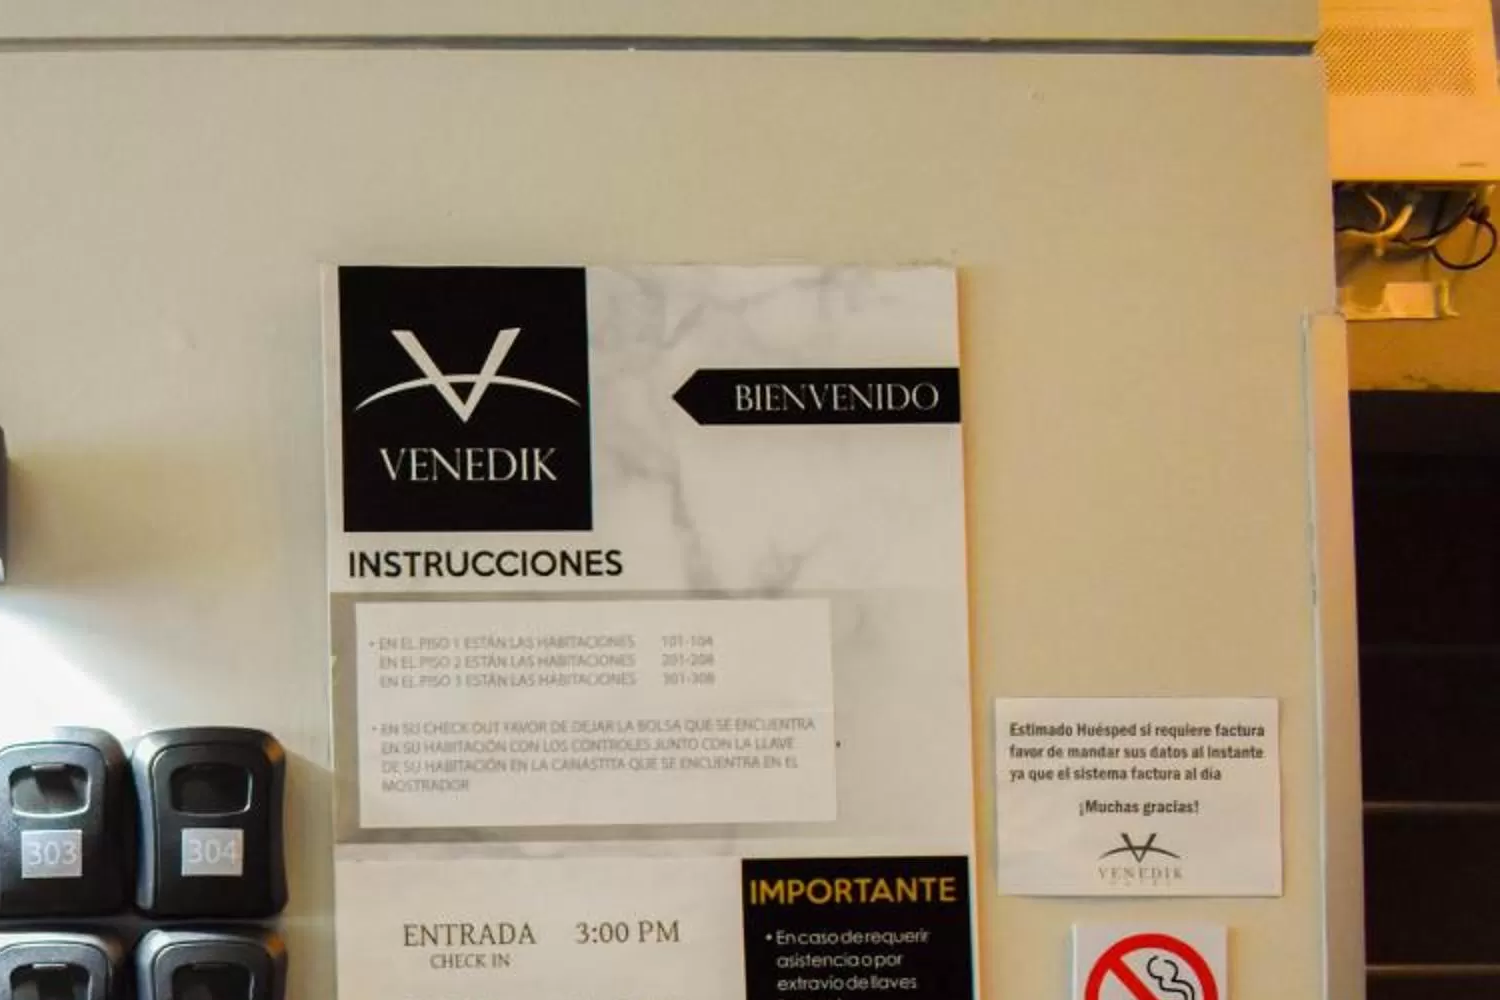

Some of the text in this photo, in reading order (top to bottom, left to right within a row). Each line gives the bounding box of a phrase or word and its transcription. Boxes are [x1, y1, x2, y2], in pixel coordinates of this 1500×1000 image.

[734, 381, 940, 412] BIENVENIDO
[379, 447, 557, 482] VENEDIK
[348, 549, 623, 577] INSTRUCCIONES
[379, 637, 397, 650] EN
[537, 636, 636, 648] HABITACIONES
[380, 656, 398, 668] EN
[537, 654, 636, 667] HABITACIONES
[380, 675, 398, 688] EN
[538, 673, 637, 686] HABITACIONES
[471, 720, 500, 734] OUT
[637, 719, 682, 732] BOLSA
[684, 719, 712, 732] QUE
[1009, 722, 1073, 737] Estimado
[1077, 722, 1137, 740] Huésped
[1155, 723, 1212, 740] requiere
[1215, 723, 1265, 737] factura
[543, 739, 568, 752] LOS
[1009, 744, 1264, 758] favor de mandar sus datos al instante
[1009, 769, 1025, 782] ya
[1028, 769, 1053, 782] que
[1057, 767, 1071, 781] el
[1073, 767, 1127, 781] sistema
[1131, 767, 1181, 781] factura
[1184, 767, 1197, 781] al
[1079, 800, 1199, 816] ¡Muchas gracias!
[27, 840, 77, 865] 303
[188, 838, 237, 865] 304
[1097, 867, 1183, 880] VENEDIK
[750, 877, 957, 905] IMPORTANTE
[403, 920, 680, 947] ENTRADA 3:00 PM
[775, 928, 929, 946] En caso de requerir
[430, 952, 511, 969] CHECK IN
[776, 953, 903, 970] asistencia o por
[846, 975, 869, 990] de
[870, 974, 917, 990] llaves
